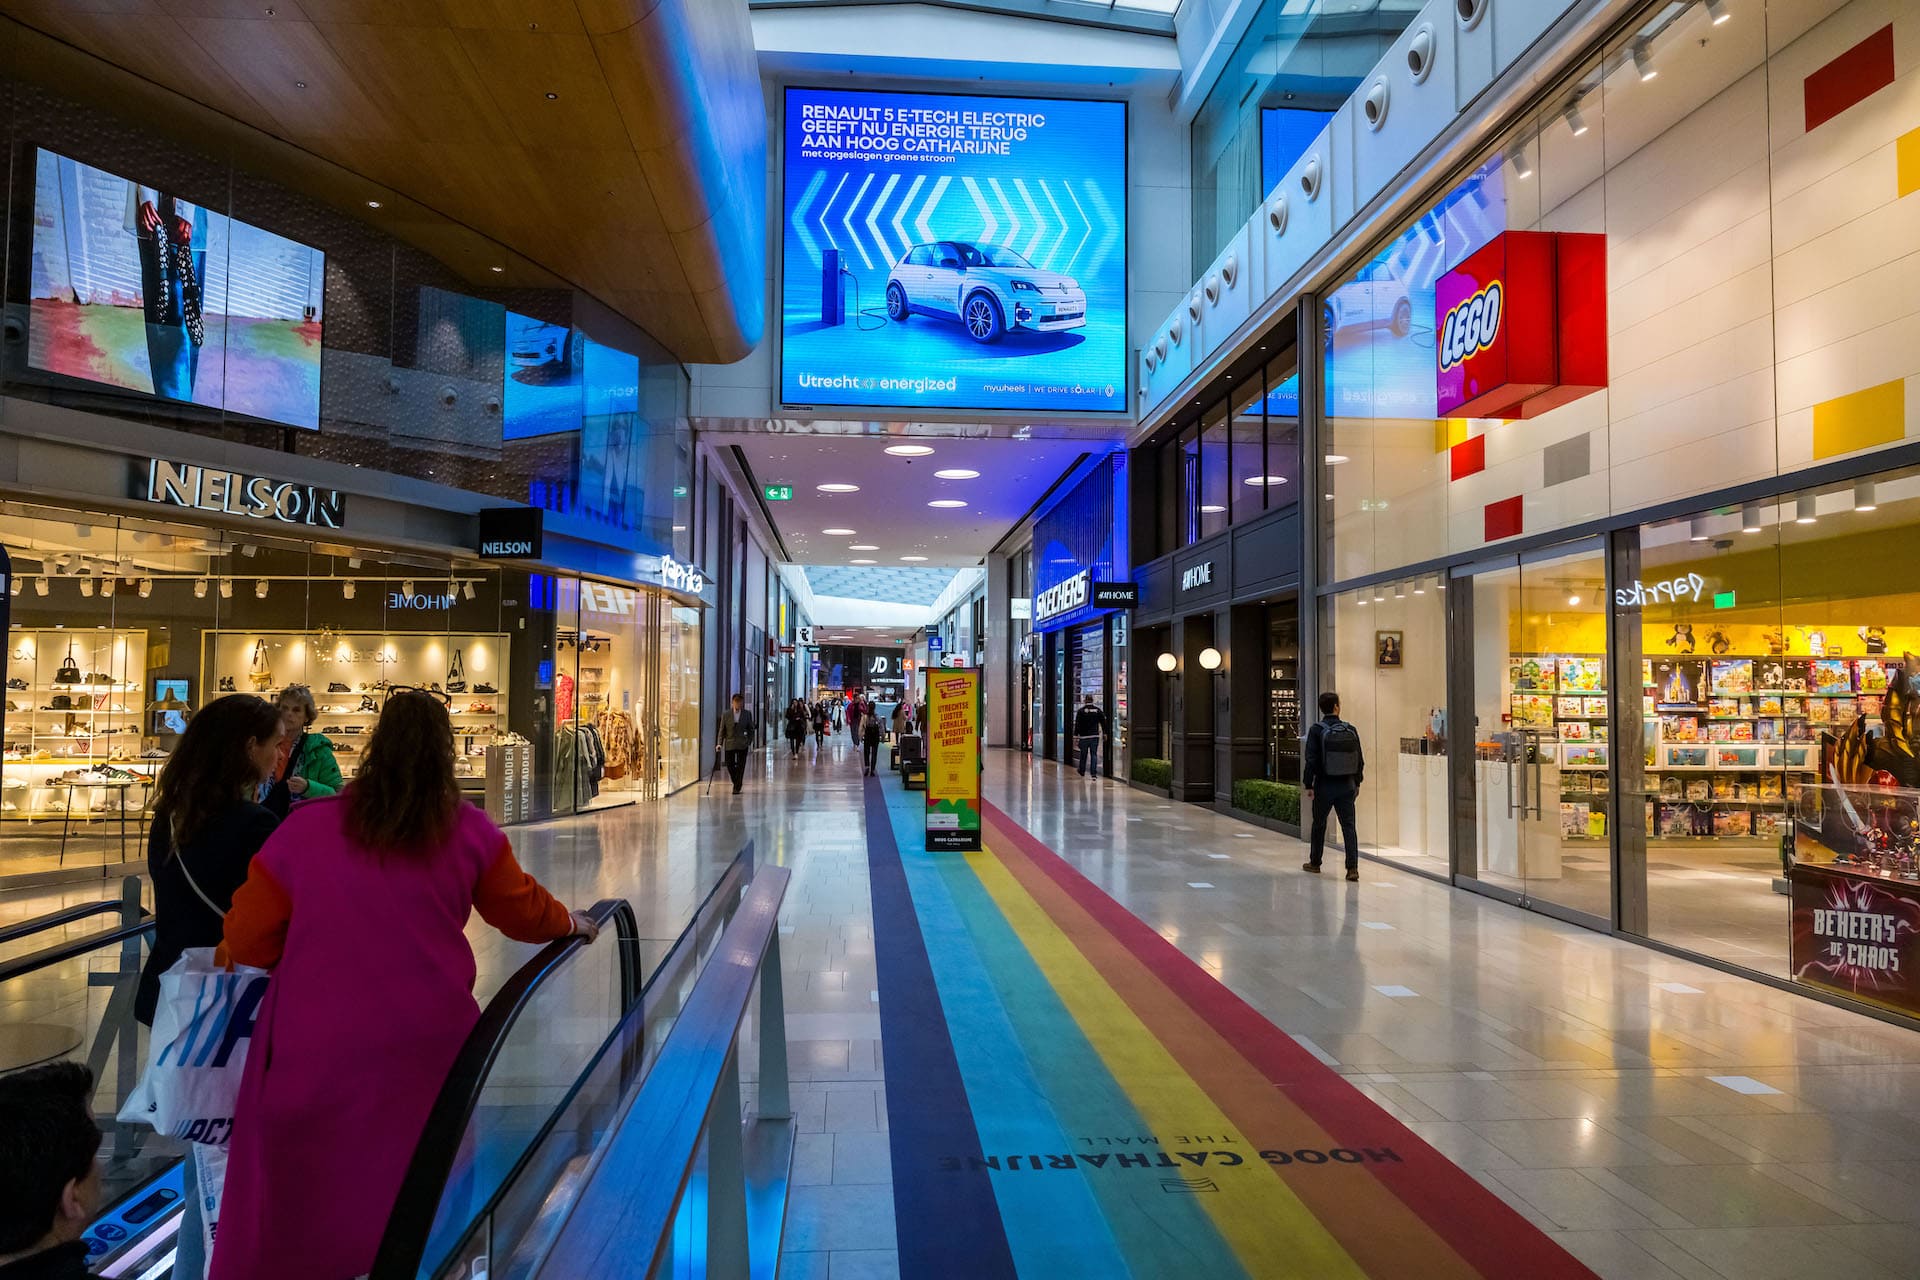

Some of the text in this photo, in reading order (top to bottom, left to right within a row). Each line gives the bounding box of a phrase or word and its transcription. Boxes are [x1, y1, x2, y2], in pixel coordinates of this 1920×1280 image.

[802, 104, 1045, 128] RENAULT 5 E-TECH ELECTRIC
[802, 119, 1027, 141] GEEFT NU ENERGIE TERUG
[802, 134, 1010, 155] AAN HOOG CATHARIJNE
[824, 151, 882, 161] opgeslagen
[884, 153, 918, 162] groene
[920, 154, 956, 162] stroom
[1440, 283, 1502, 370] LEGO
[799, 372, 957, 394] Utrecht energized
[984, 384, 1025, 393] mywheels
[148, 458, 341, 529] NELSON
[482, 541, 531, 554] NELSON
[661, 554, 702, 592] Paprika
[1191, 562, 1211, 588] HOME
[1036, 569, 1087, 621] SKECHERS
[1110, 591, 1134, 600] HOME
[870, 656, 888, 673] JD
[938, 702, 968, 713] UTRECHTSE
[504, 748, 514, 824] STEVE MADDEN
[1814, 909, 1895, 943] BEHEERS
[1830, 942, 1899, 971] DE CHAOS
[1078, 1135, 1235, 1146] THE MALL
[938, 1146, 1403, 1172] HOOG CATHARIJNE
